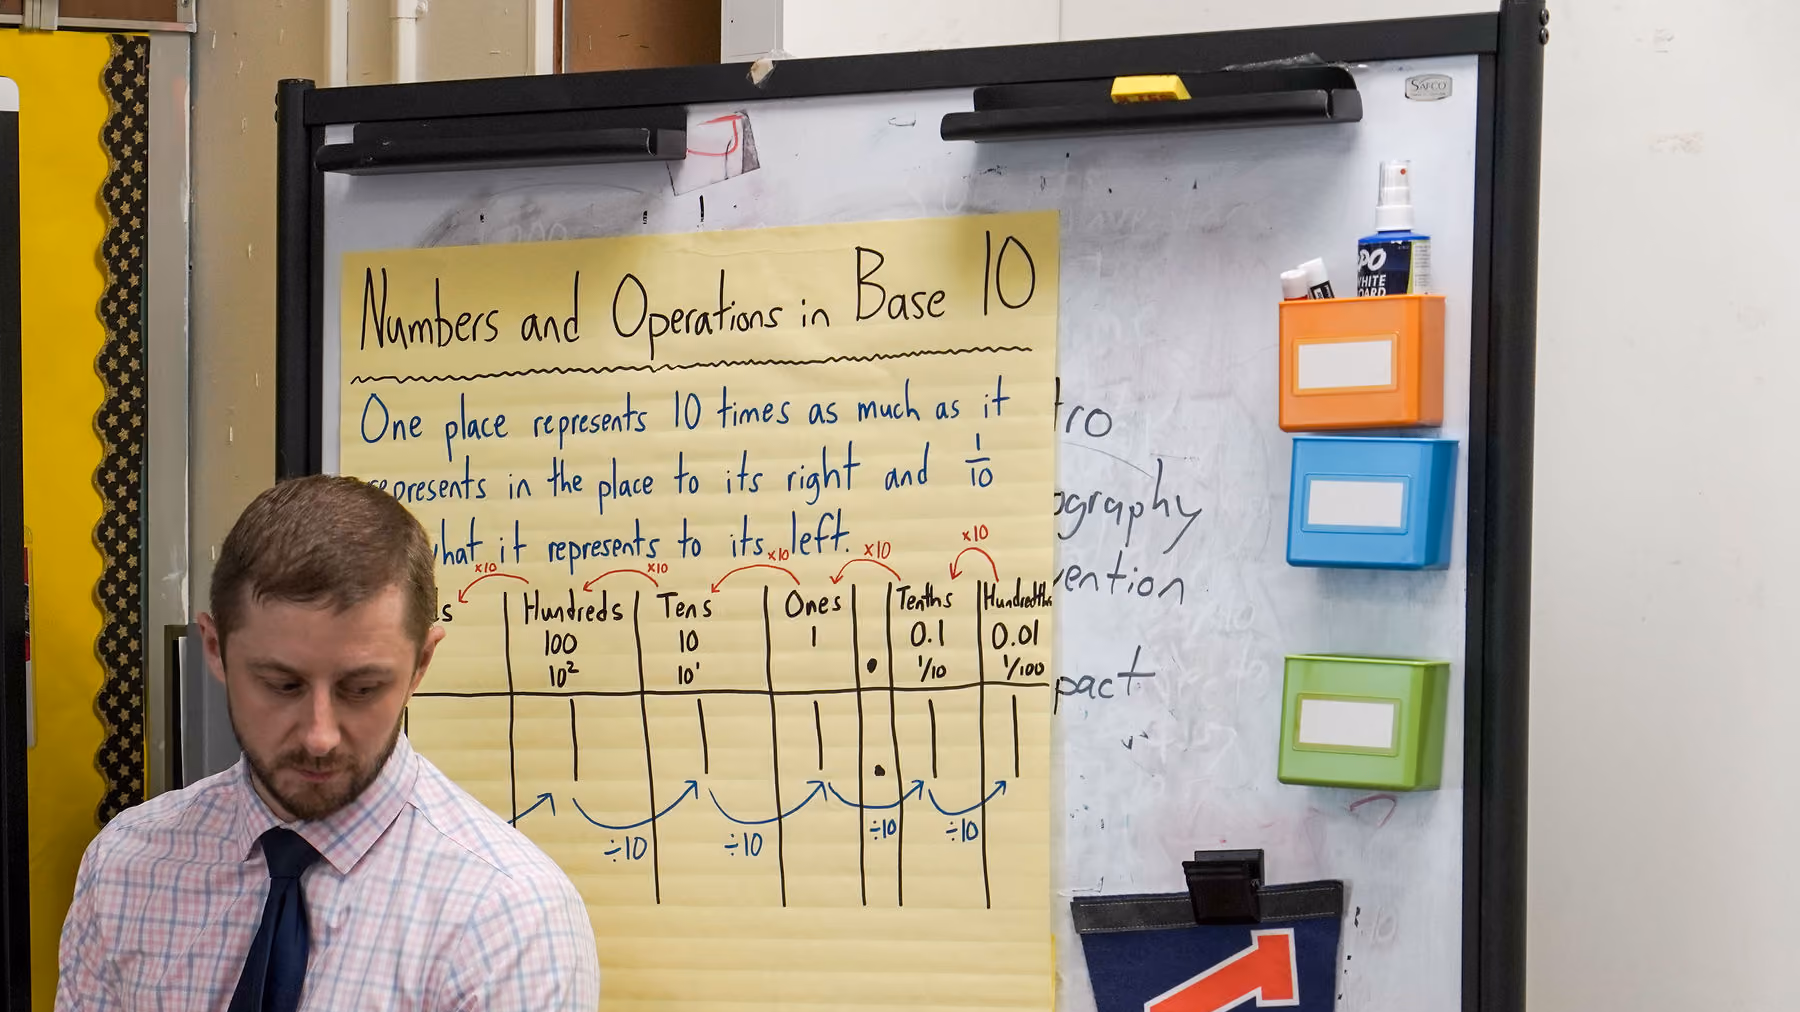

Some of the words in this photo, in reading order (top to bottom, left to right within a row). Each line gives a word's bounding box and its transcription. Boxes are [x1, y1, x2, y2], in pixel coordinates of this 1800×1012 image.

[361, 267, 499, 350] Numbers
[521, 270, 580, 343] and
[613, 269, 783, 361] Operations
[801, 298, 830, 327] in
[855, 246, 946, 321] Base
[984, 230, 1036, 316] 10
[361, 392, 423, 443] One
[445, 392, 509, 462] place
[534, 391, 648, 450] represents
[675, 390, 702, 430] 10
[717, 385, 791, 429] times
[809, 402, 839, 425] as
[858, 378, 920, 422] much
[935, 400, 960, 420] as
[984, 374, 1010, 418] it
[508, 473, 531, 499] in
[547, 456, 582, 498] the
[598, 457, 653, 515] place
[674, 451, 699, 494] to
[726, 450, 763, 494] its
[787, 440, 860, 506] right
[885, 441, 930, 491] and
[433, 517, 483, 566] hat
[500, 519, 527, 564] it
[548, 517, 660, 576] represents
[678, 517, 702, 559] to
[730, 515, 764, 556] its
[524, 588, 624, 625] Hundreds
[656, 591, 712, 619] Tens
[785, 589, 841, 618] Ones
[896, 581, 953, 612] Tenths
[545, 629, 577, 656] 100
[679, 629, 699, 652] 10
[910, 619, 945, 648] 0.1
[991, 619, 1039, 650] 0.01
